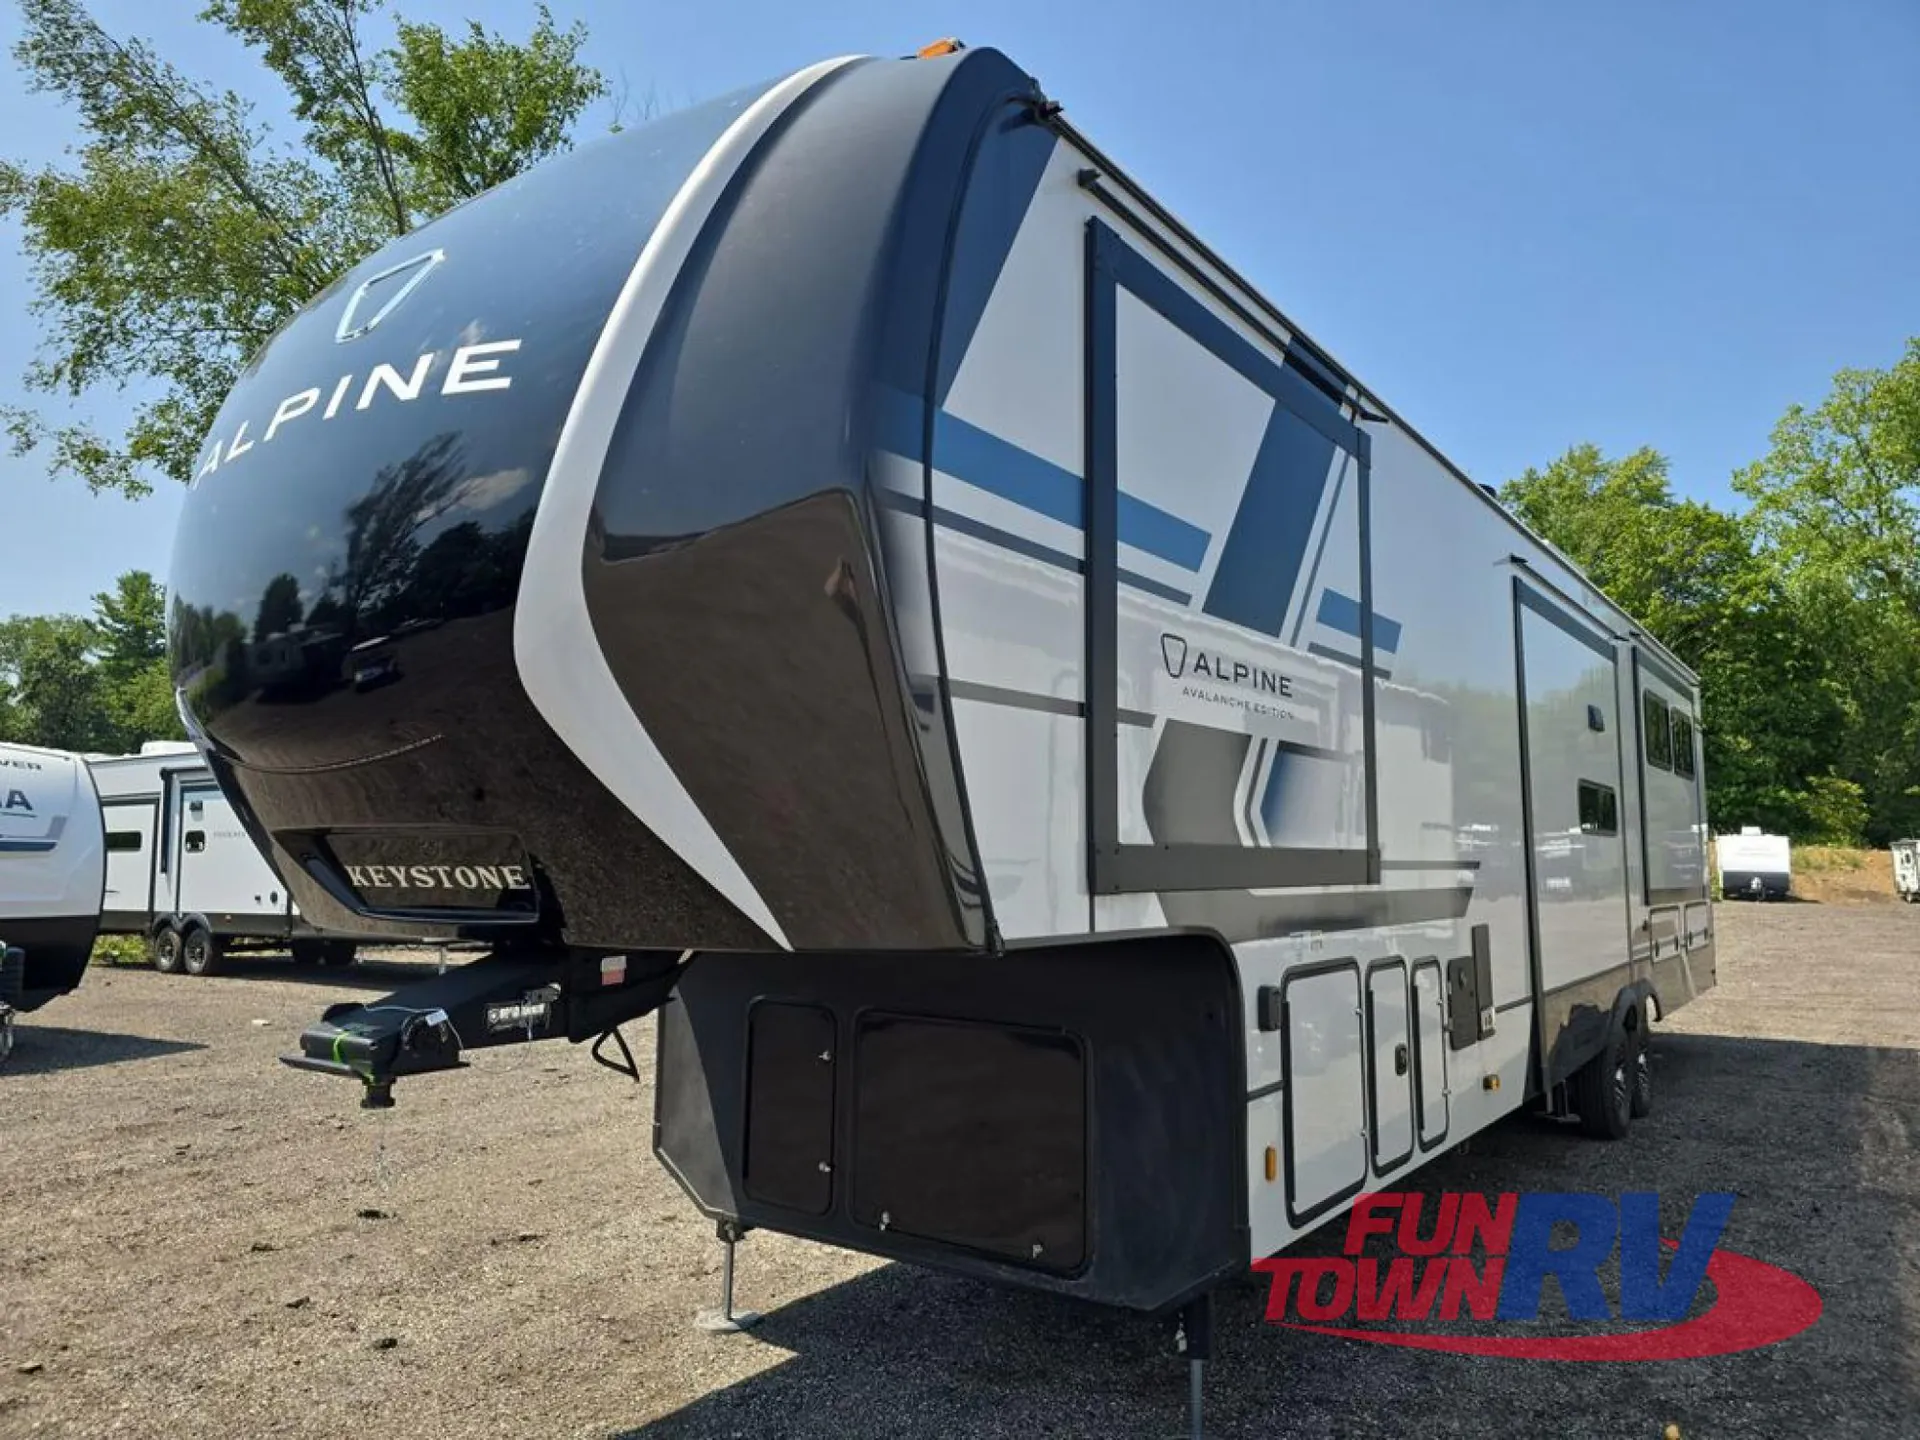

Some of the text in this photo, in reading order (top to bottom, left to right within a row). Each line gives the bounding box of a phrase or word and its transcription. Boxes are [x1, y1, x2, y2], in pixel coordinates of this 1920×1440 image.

[191, 339, 522, 490] ALPINE
[1193, 652, 1293, 698] ALPINE
[1182, 686, 1250, 712] AVALANCHE
[0, 789, 33, 811] A
[345, 864, 531, 890] KEYSTONE
